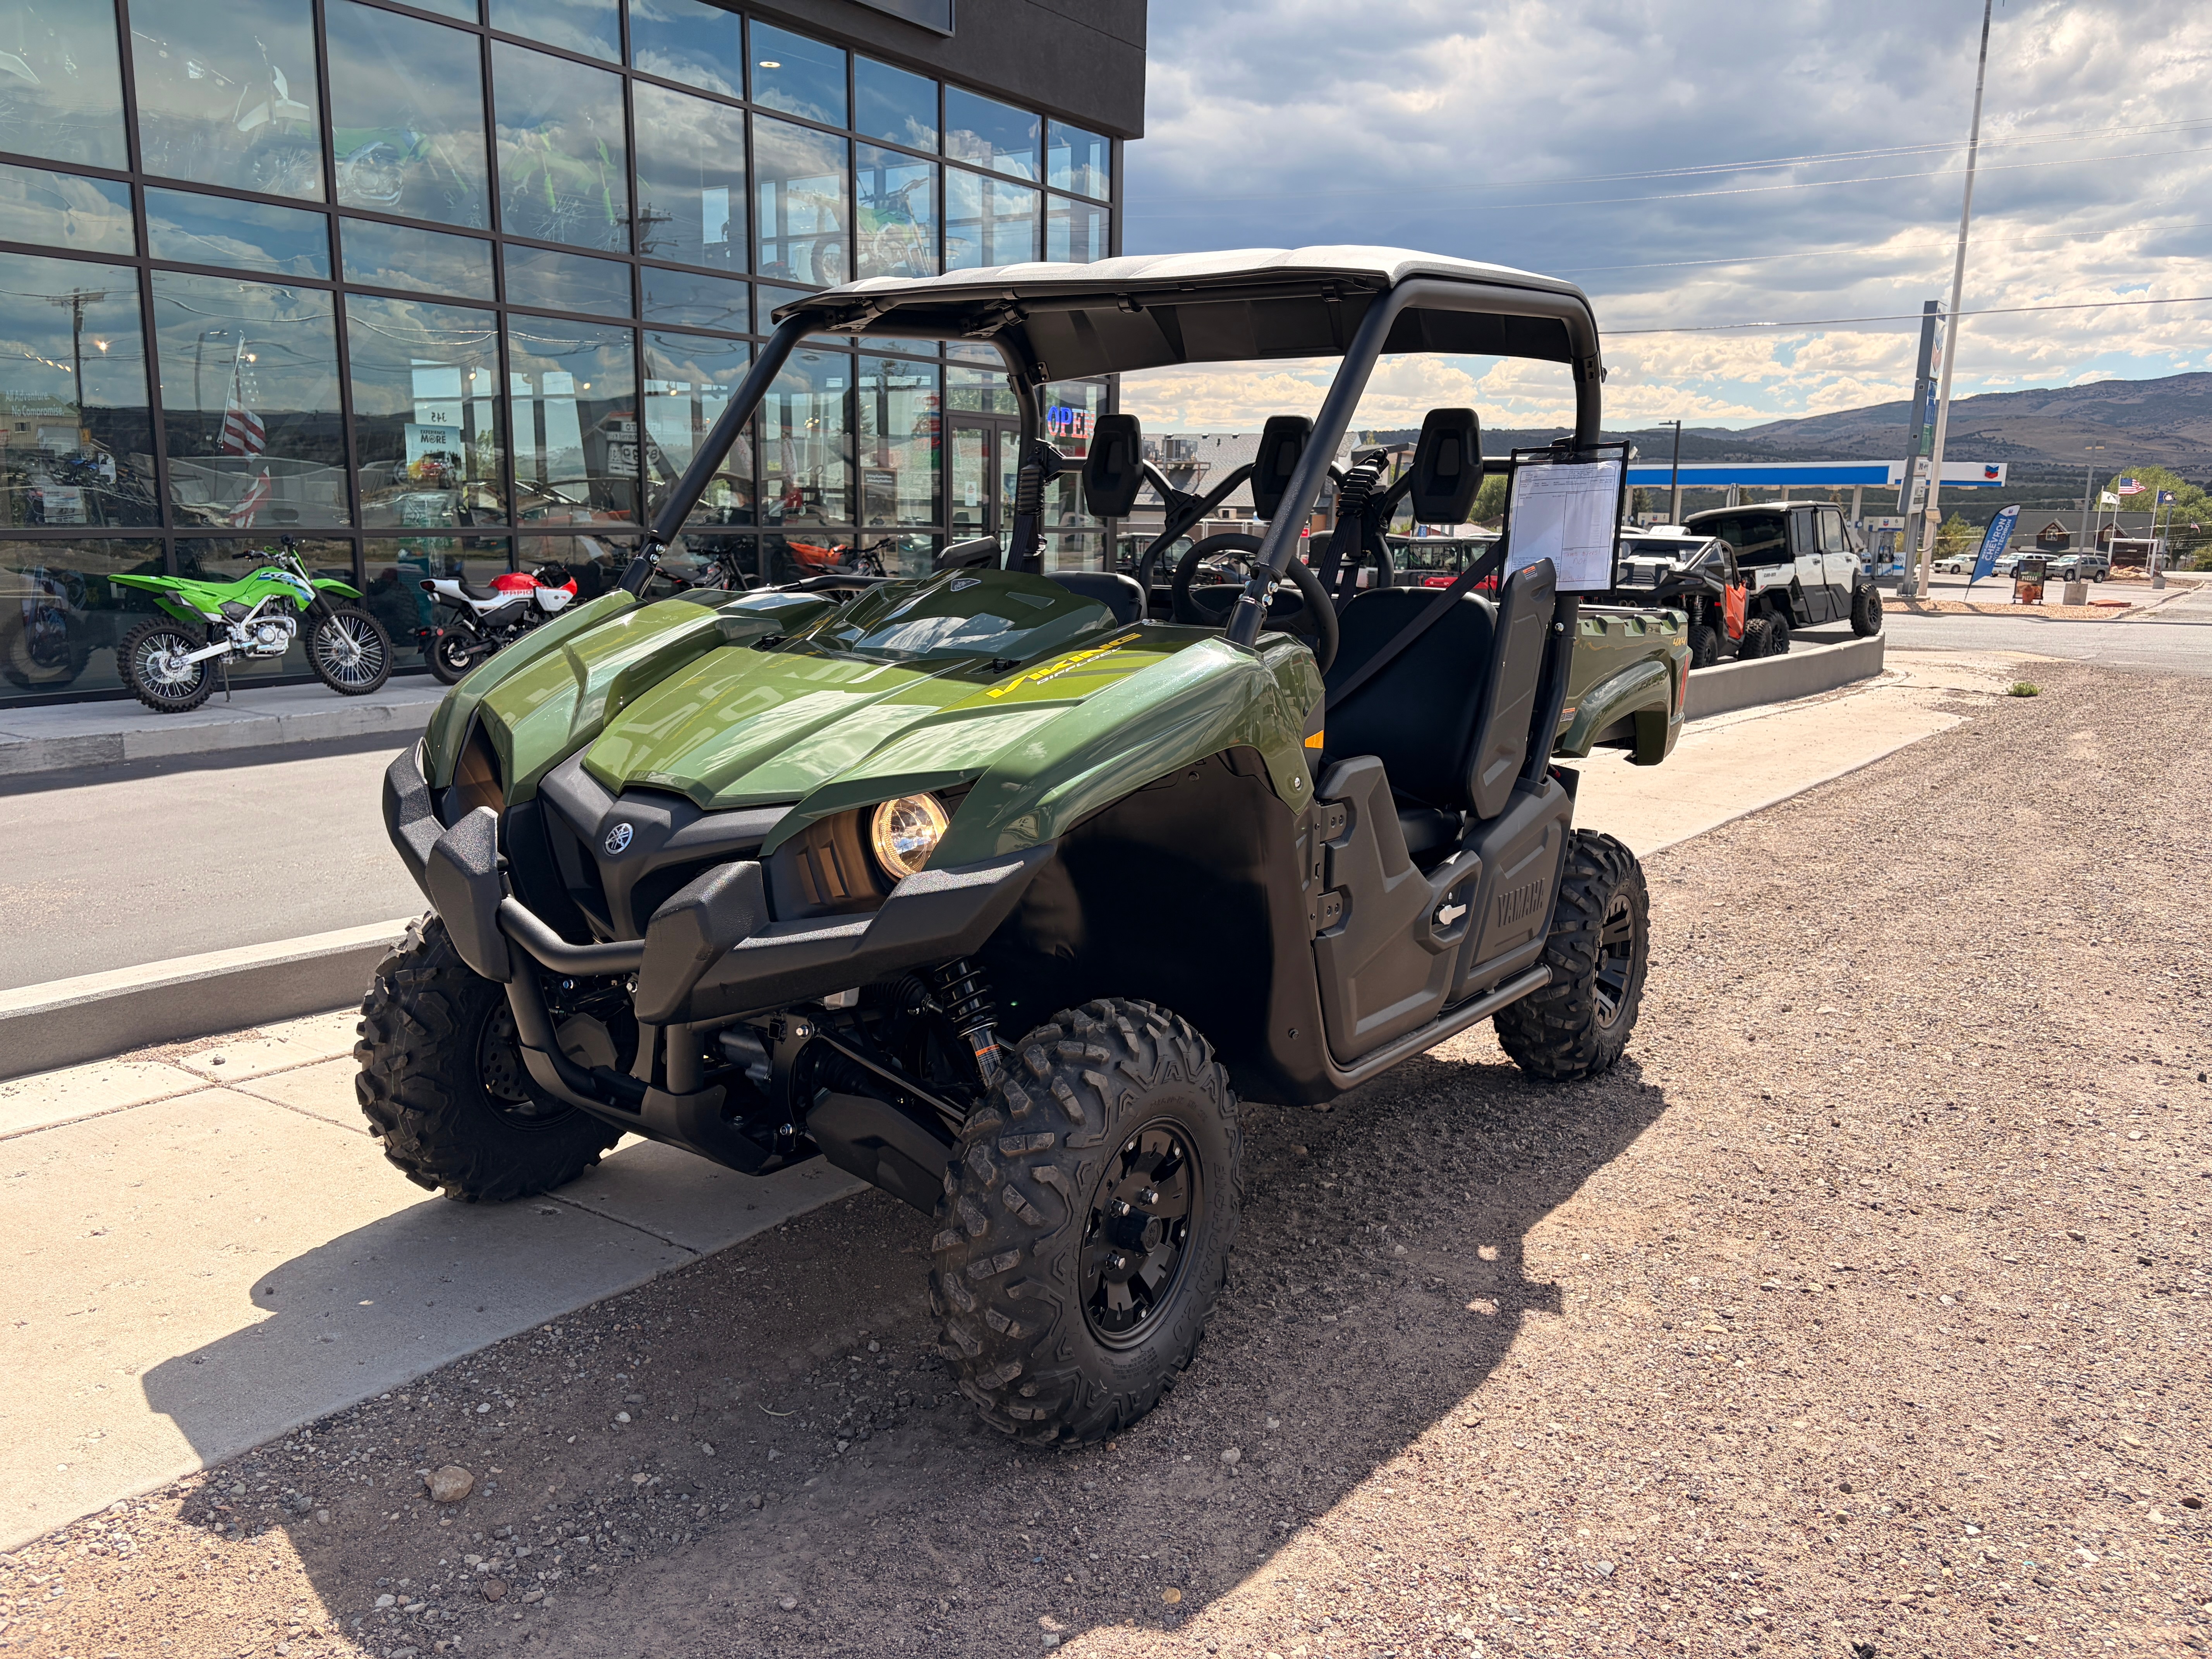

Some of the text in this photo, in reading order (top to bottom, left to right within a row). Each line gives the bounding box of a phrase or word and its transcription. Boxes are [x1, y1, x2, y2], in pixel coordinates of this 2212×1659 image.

[5, 390, 50, 402] All Adventure.
[12, 405, 64, 419] No Compromise.
[1048, 406, 1096, 439] OPEN
[1985, 518, 2006, 561] CHEVRON
[1999, 519, 2012, 547] TECHRON
[986, 632, 1142, 698] VIKING
[1498, 877, 1545, 927] YAMAHA
